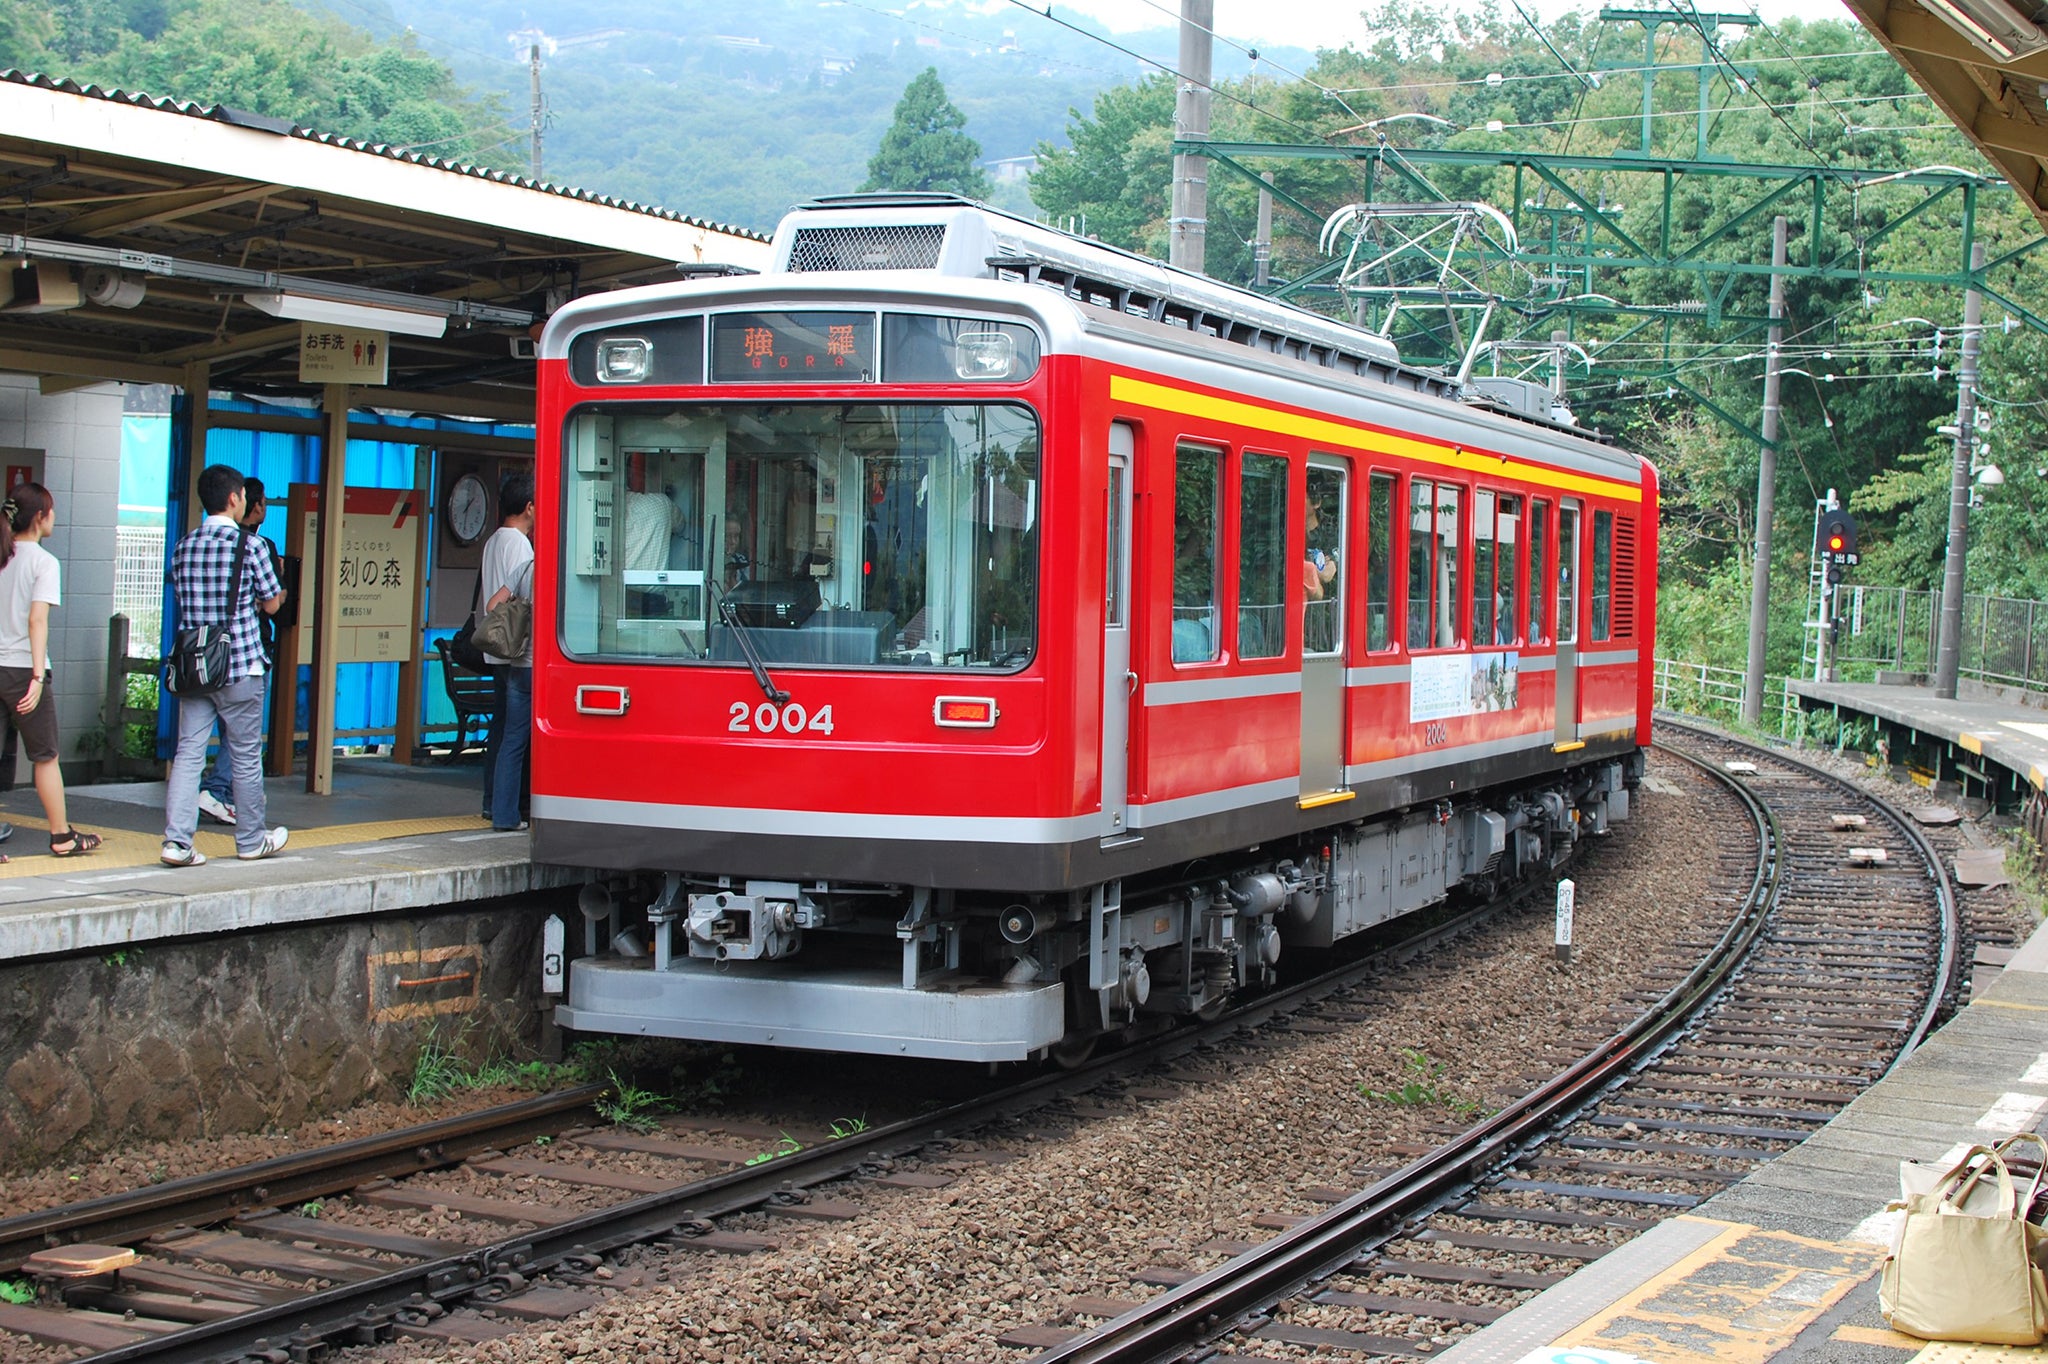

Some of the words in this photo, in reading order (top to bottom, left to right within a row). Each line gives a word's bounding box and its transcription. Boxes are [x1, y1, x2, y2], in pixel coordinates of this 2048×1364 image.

[306, 333, 345, 350] お手洗
[752, 355, 845, 369] GORA
[340, 556, 402, 589] 刻の森
[728, 701, 834, 736] 2004
[1426, 723, 1447, 747] 2004
[545, 953, 562, 976] 3
